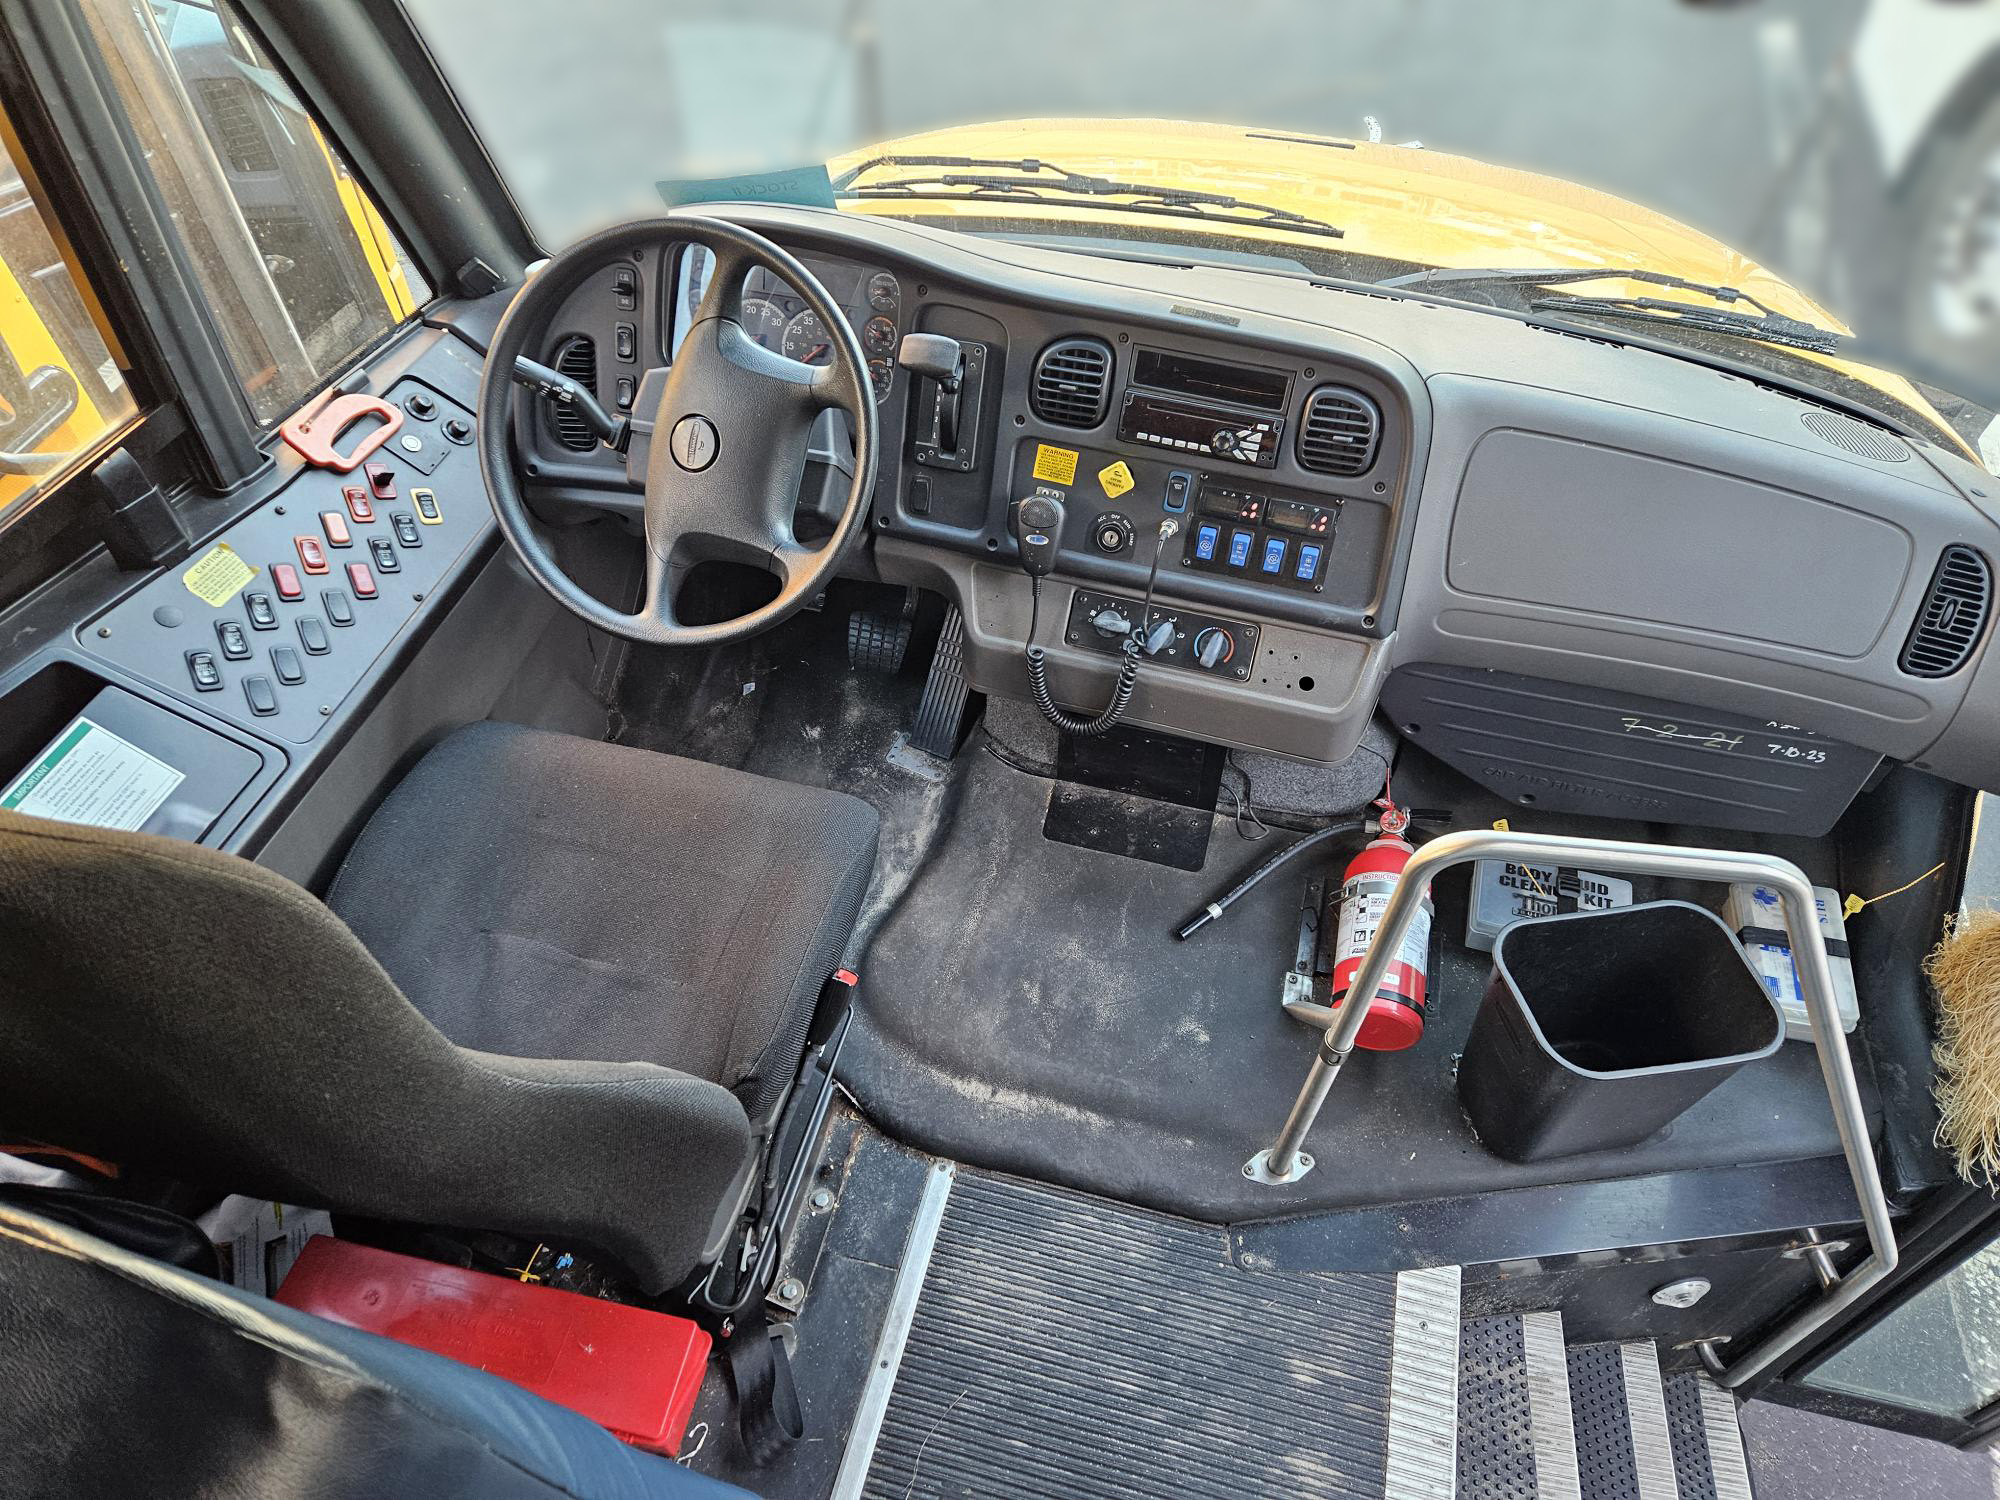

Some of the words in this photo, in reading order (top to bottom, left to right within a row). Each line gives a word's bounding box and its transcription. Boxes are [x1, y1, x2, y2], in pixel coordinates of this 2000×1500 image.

[746, 306, 757, 314] 20
[761, 308, 771, 316] 25
[771, 318, 782, 327] 30
[803, 316, 814, 325] 35
[792, 325, 802, 334] 25
[785, 341, 794, 350] 15
[1044, 447, 1074, 459] WARNING
[194, 549, 224, 574] CAUTION
[12, 765, 50, 801] IMPORTANT
[1505, 862, 1552, 882] BODY
[1362, 873, 1400, 881] INSTRUCTION
[1584, 893, 1613, 909] KIT
